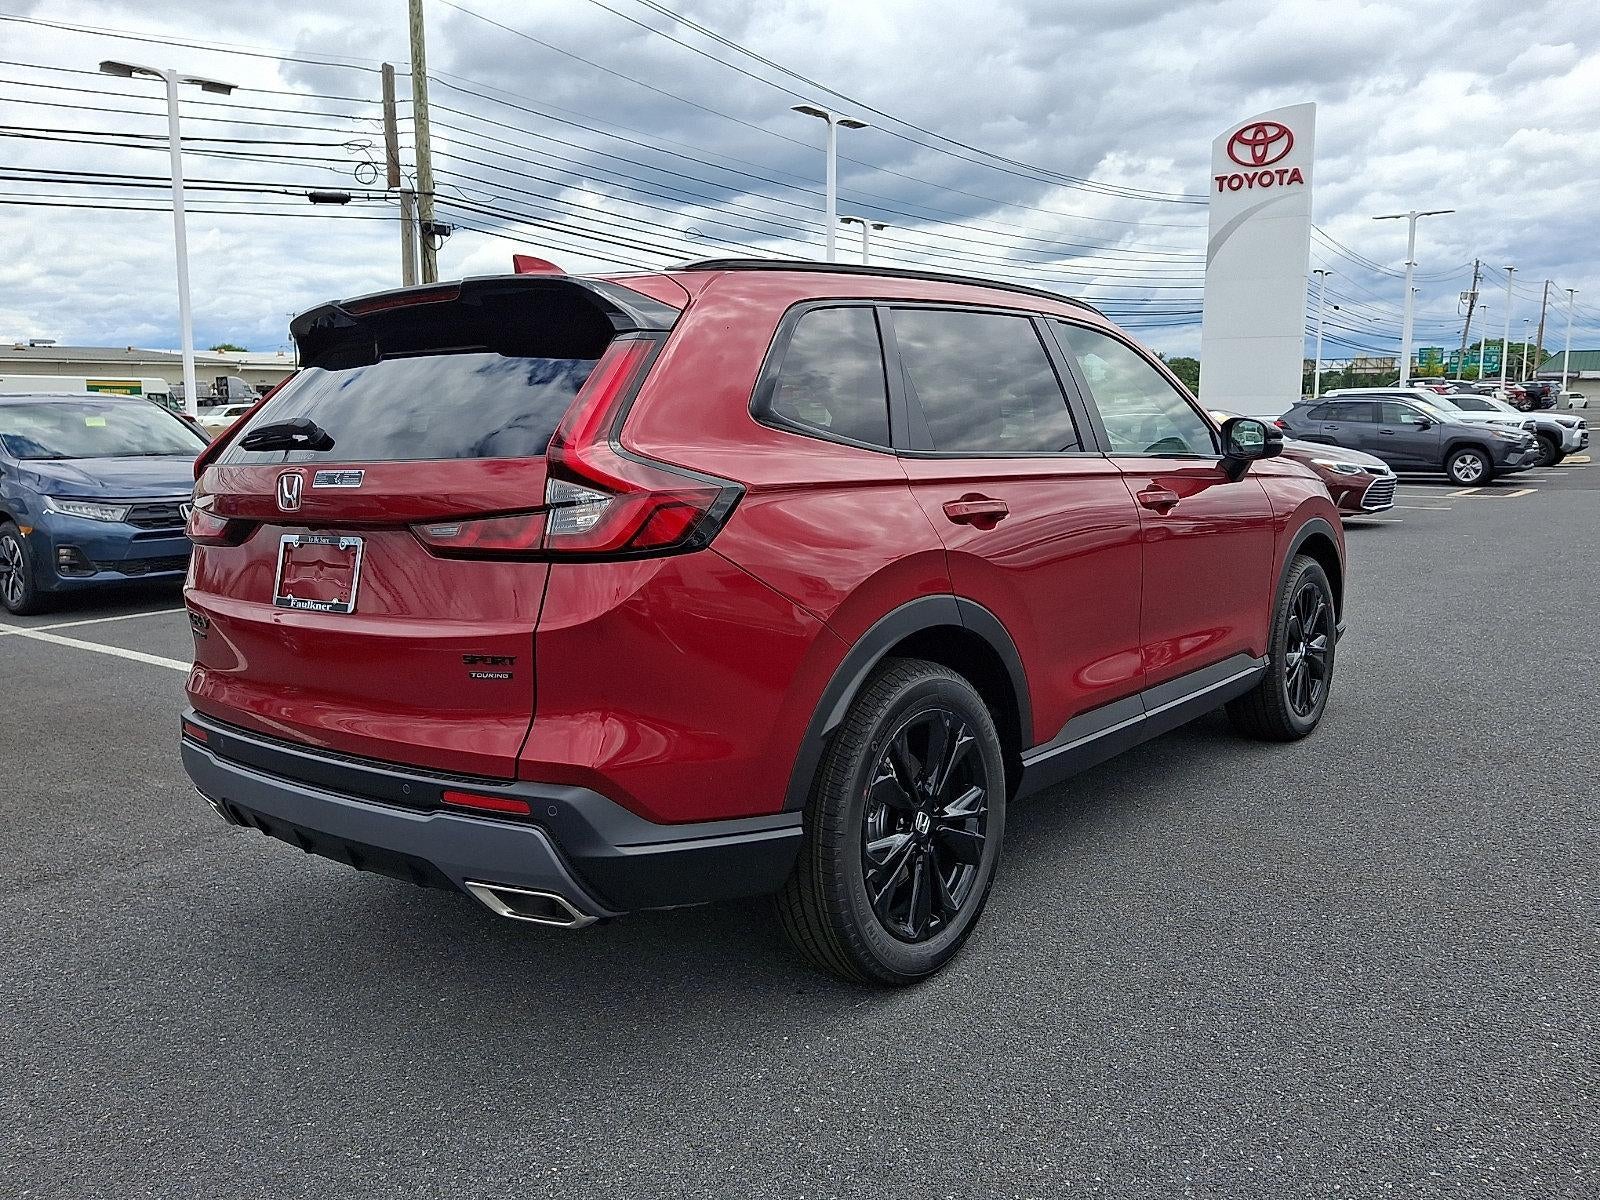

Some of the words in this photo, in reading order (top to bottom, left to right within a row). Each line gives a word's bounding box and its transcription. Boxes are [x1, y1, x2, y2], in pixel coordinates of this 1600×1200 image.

[1214, 168, 1304, 192] TOYOTA
[291, 600, 332, 611] Faulkner
[462, 654, 517, 665] SPORT
